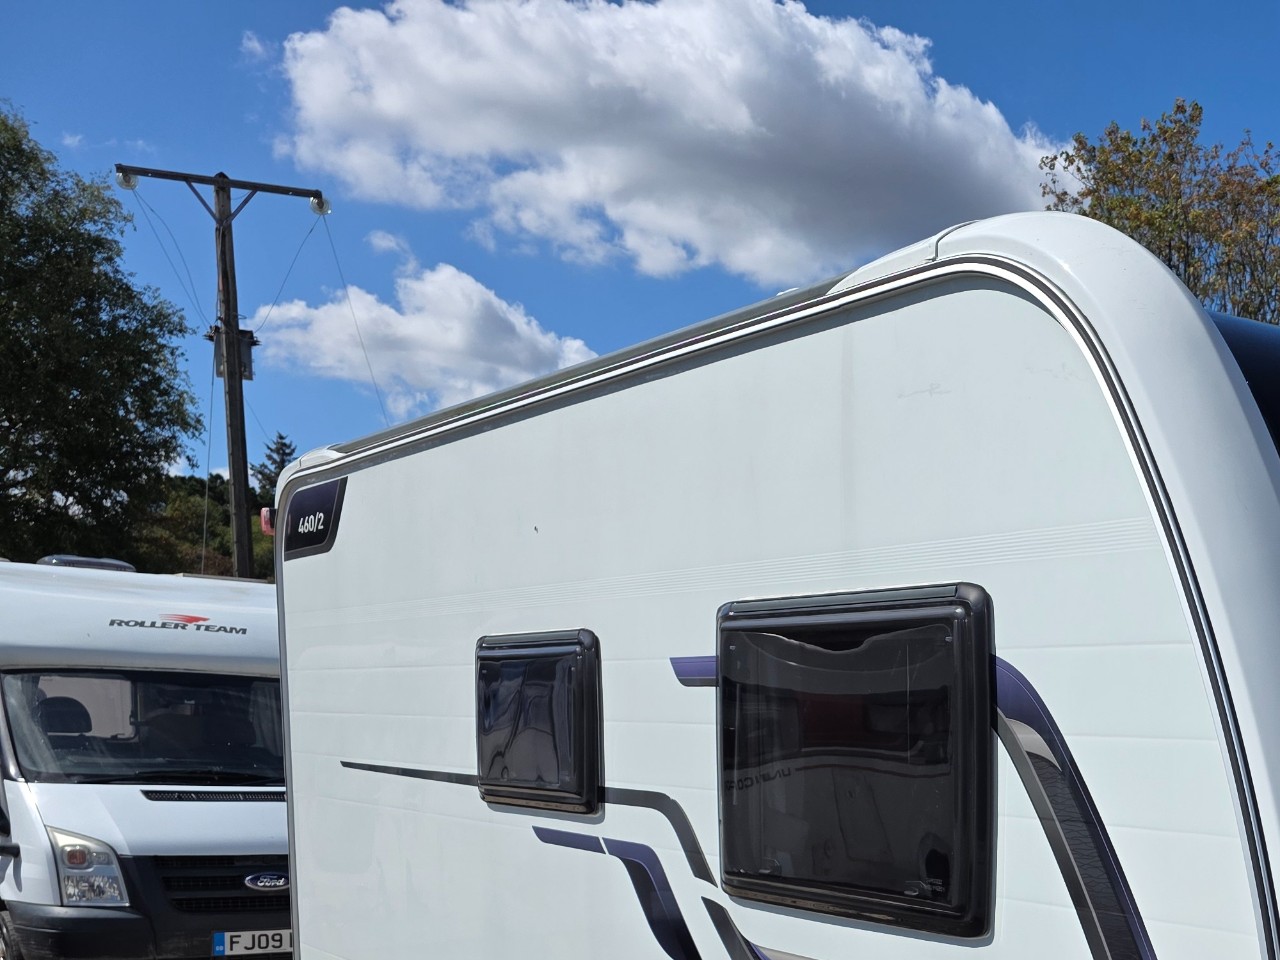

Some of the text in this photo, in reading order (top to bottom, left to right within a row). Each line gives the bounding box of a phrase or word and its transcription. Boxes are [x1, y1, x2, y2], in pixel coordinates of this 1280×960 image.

[298, 511, 325, 534] 460/2
[109, 618, 247, 635] ROLLER TEAM
[257, 875, 286, 887] Ford
